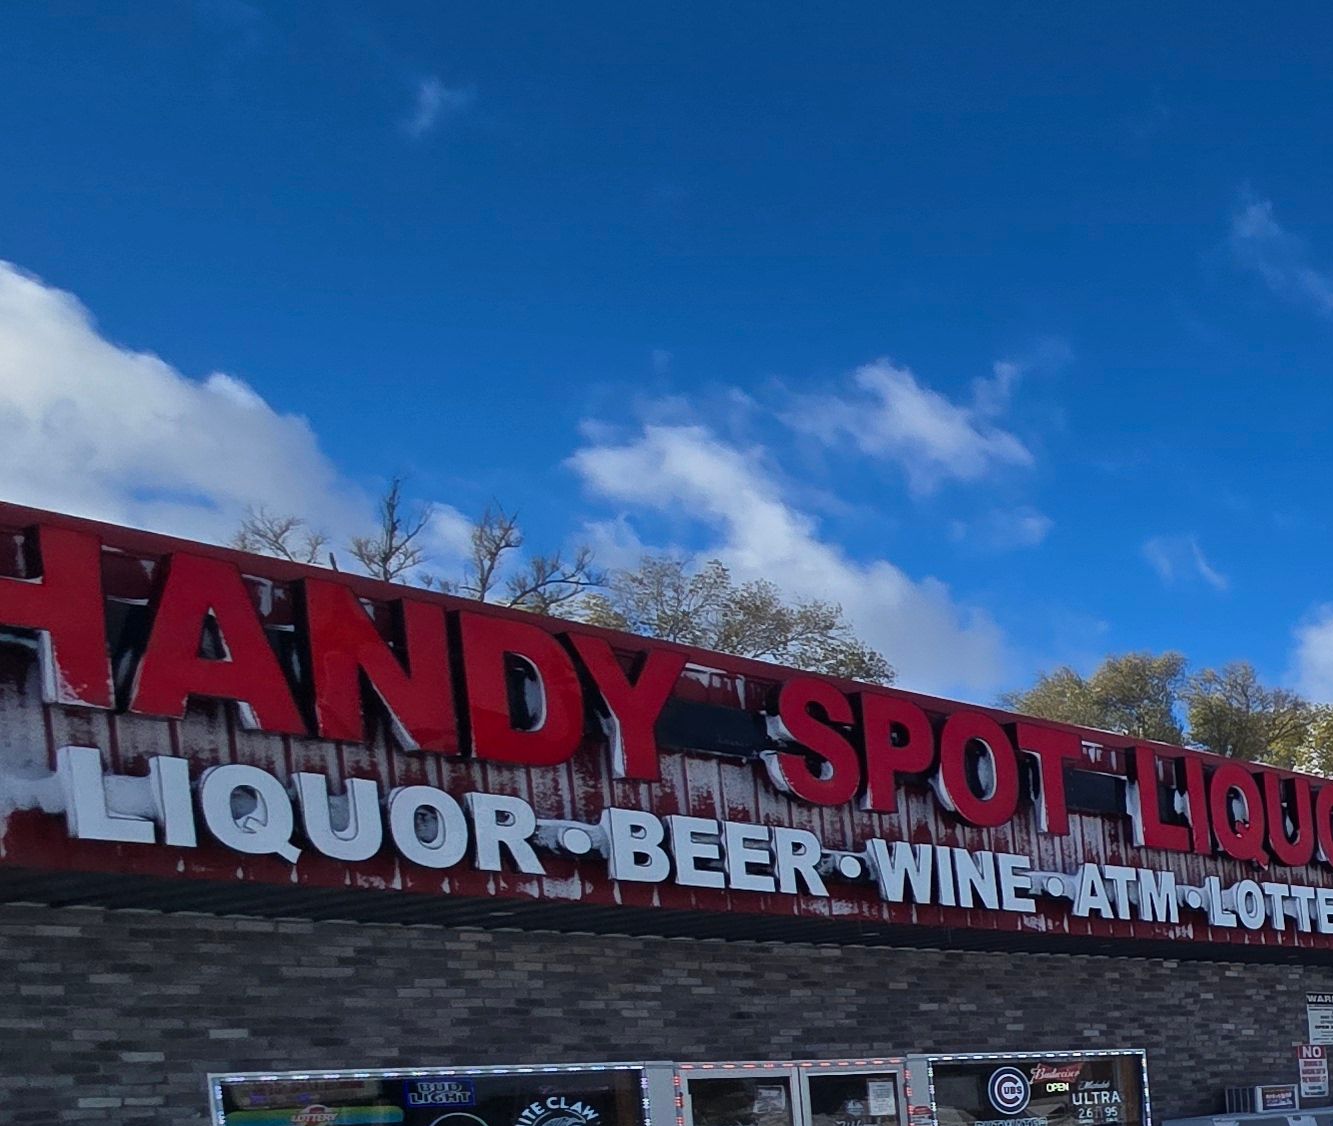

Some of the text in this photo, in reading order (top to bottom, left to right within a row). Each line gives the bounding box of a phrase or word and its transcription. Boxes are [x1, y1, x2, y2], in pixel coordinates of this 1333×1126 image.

[0, 523, 688, 781] HANDY
[762, 677, 1082, 836] SPOT
[57, 745, 546, 876] LIQUOR
[606, 808, 830, 898] BEER
[866, 837, 1037, 913] WINE
[1072, 862, 1180, 924] ATM
[1302, 1046, 1322, 1058] NO
[1030, 1063, 1081, 1084] Budweiser
[417, 1081, 463, 1093] BUD
[1046, 1082, 1070, 1093] OPEN
[408, 1091, 472, 1105] LIGHT
[1072, 1091, 1122, 1106] ULTRA
[545, 1096, 600, 1122] CLAW
[1104, 1106, 1118, 1117] 95
[291, 1113, 338, 1123] LOTTERY
